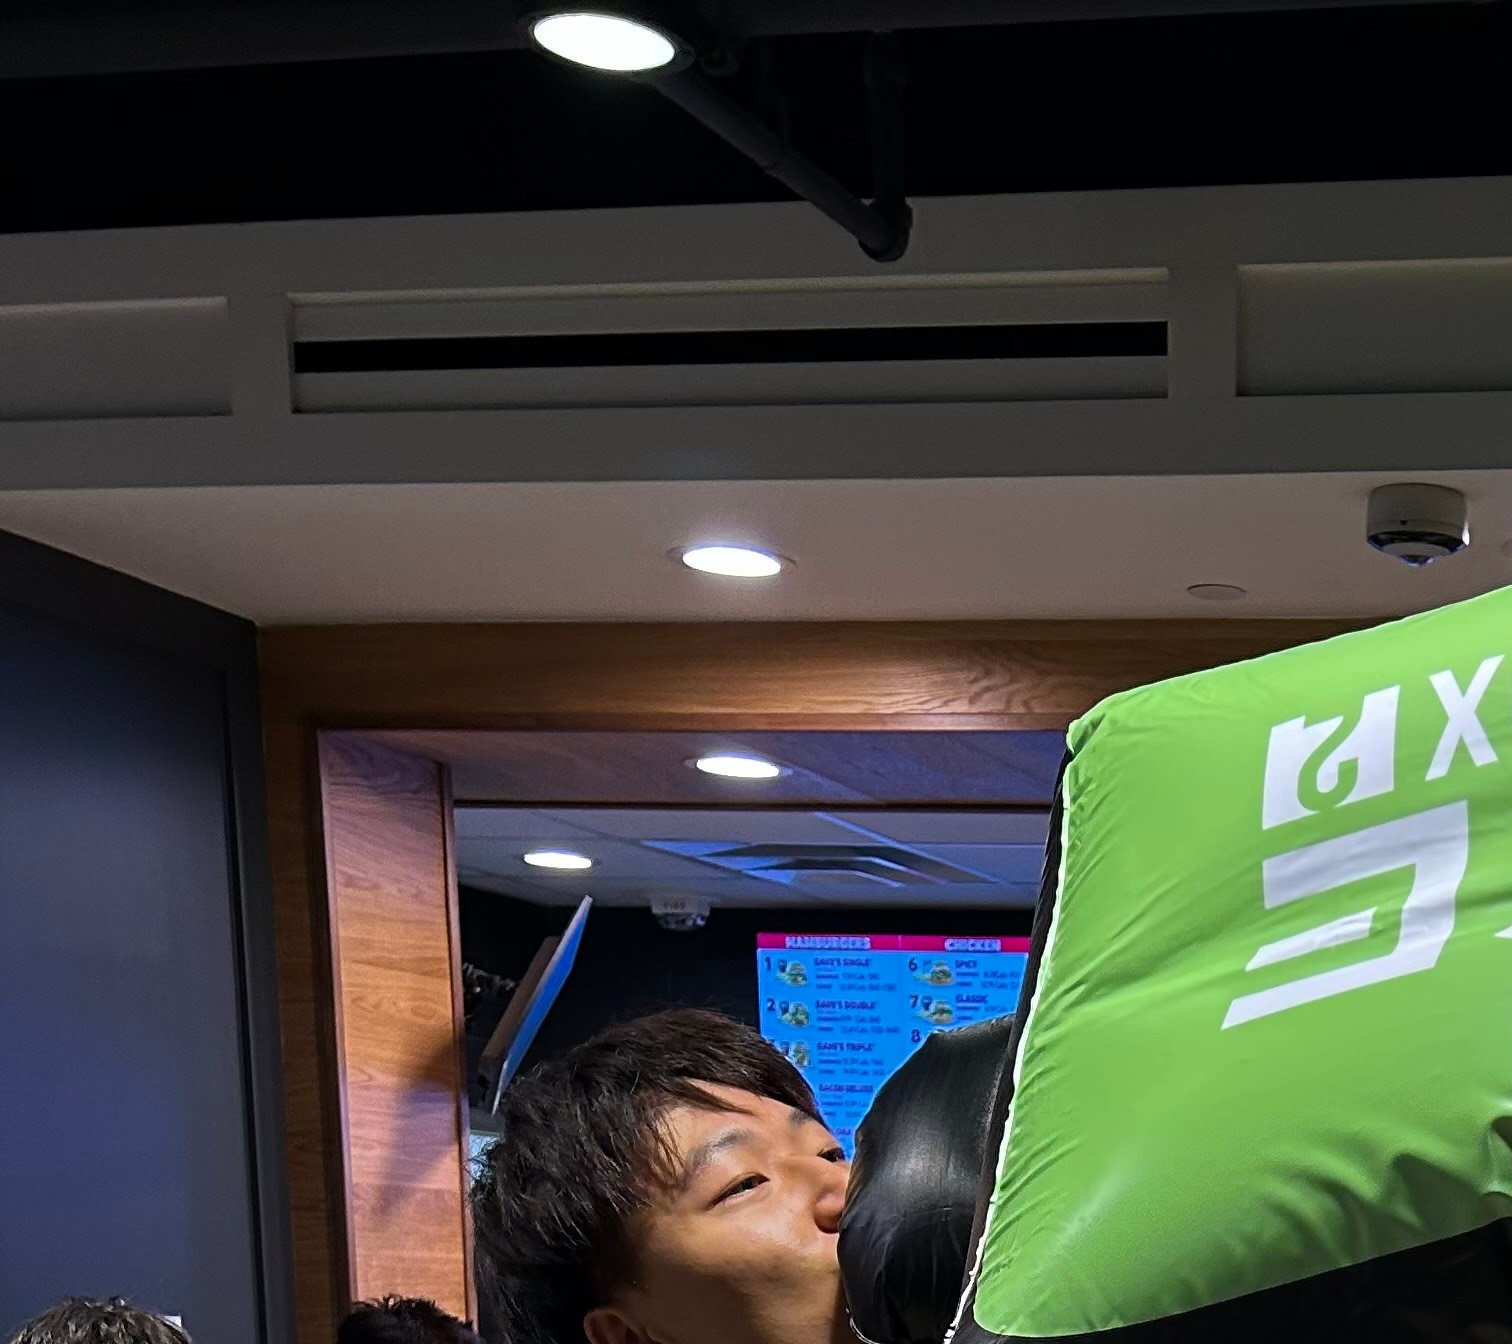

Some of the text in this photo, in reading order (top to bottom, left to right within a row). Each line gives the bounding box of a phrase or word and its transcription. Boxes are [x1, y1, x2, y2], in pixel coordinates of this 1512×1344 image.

[785, 936, 871, 950] HAMBURGERS
[945, 938, 1001, 951] CHICKEN
[908, 958, 917, 972] 6
[767, 998, 776, 1012] 2
[909, 995, 918, 1008] 7
